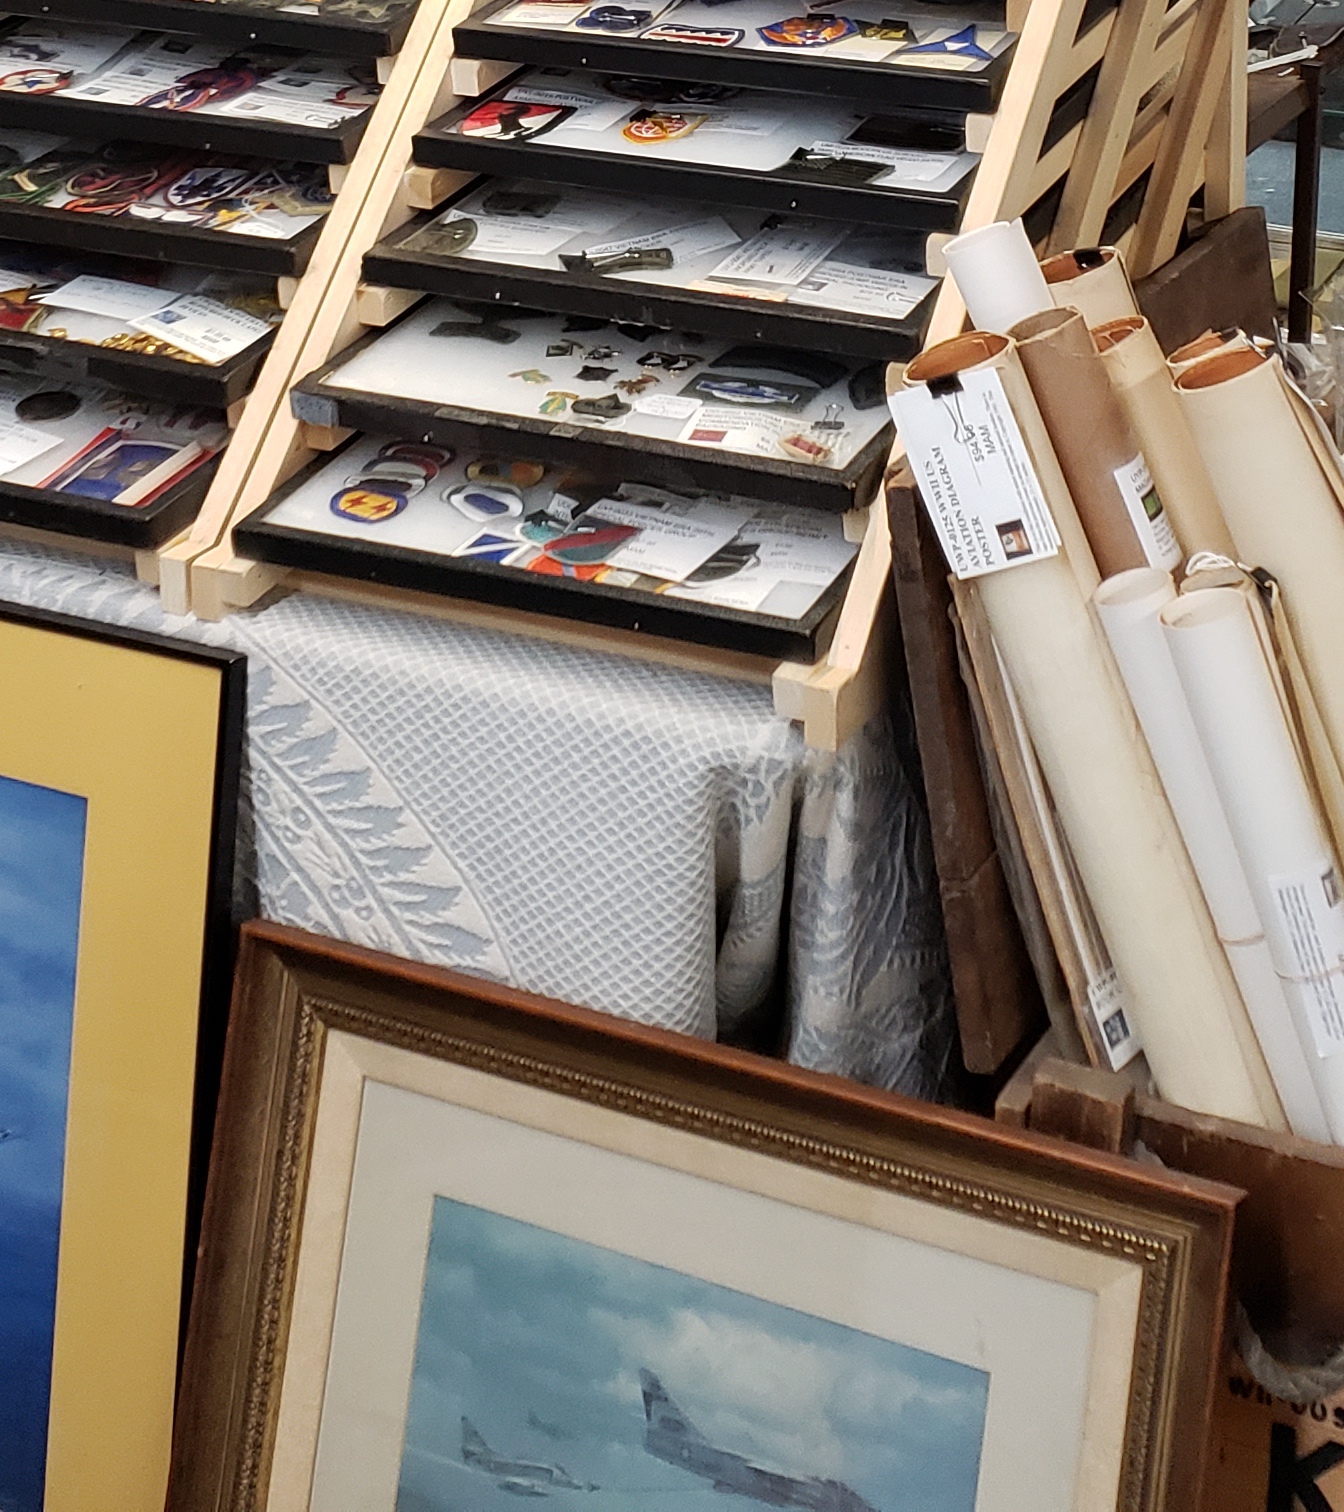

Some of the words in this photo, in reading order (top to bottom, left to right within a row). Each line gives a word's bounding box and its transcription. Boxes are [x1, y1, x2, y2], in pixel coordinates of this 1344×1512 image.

[977, 424, 997, 455] MAM
[924, 460, 936, 478] US
[931, 445, 962, 508] DIAGRAM
[929, 479, 947, 517] WWII
[942, 516, 969, 573] UWP-0125
[956, 509, 982, 568] AVIATION
[971, 515, 996, 566] POSTER
